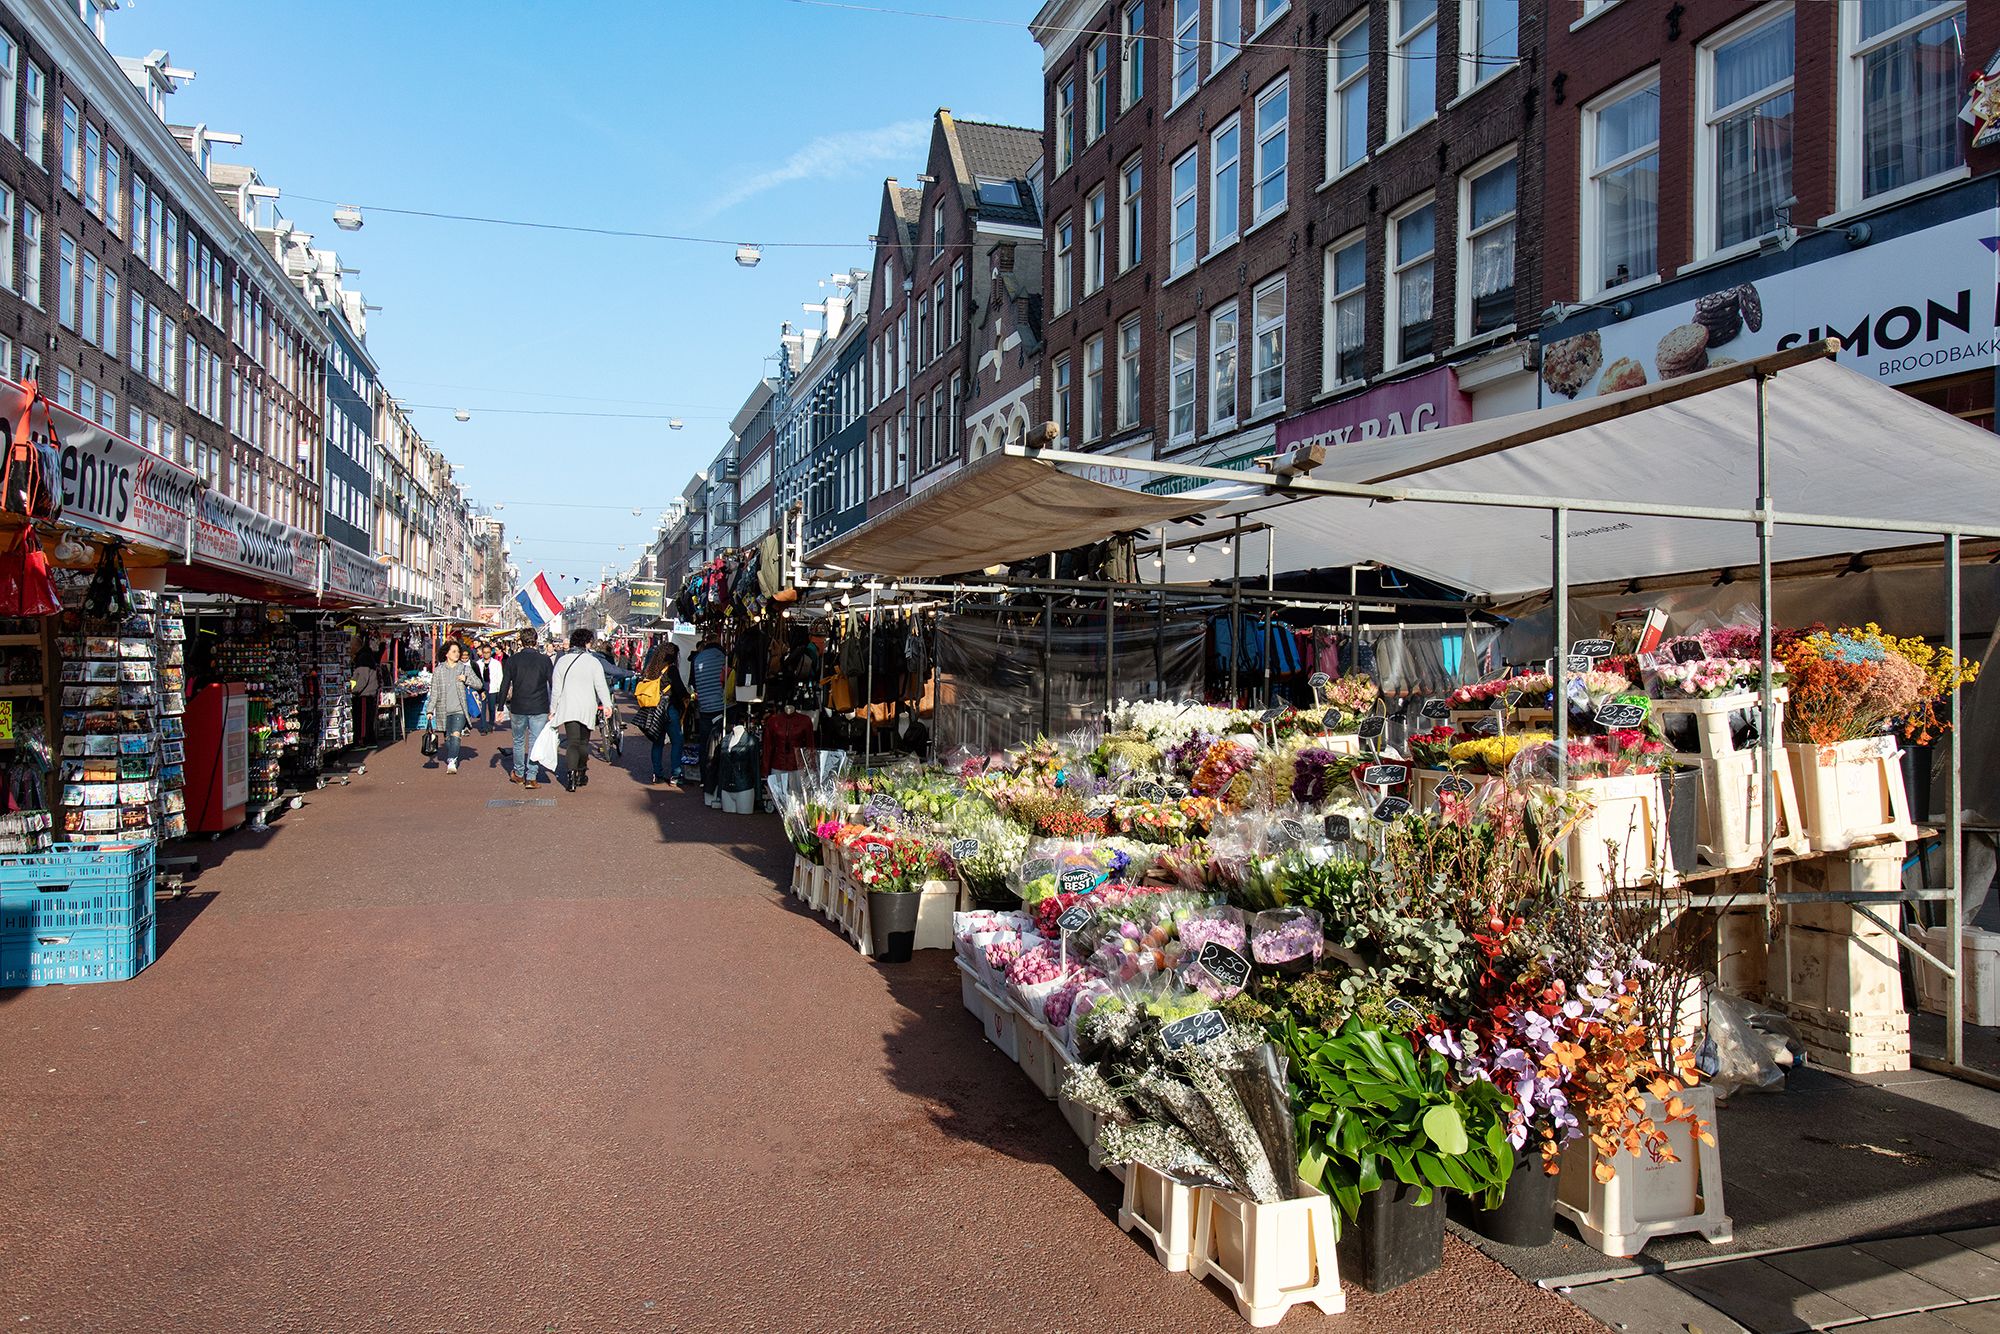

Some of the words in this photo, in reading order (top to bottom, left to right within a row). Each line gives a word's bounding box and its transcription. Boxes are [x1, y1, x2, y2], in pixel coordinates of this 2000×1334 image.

[1286, 425, 1353, 453] CTY
[140, 459, 193, 514] Kruithof
[1079, 464, 1128, 485] AGERIJ
[238, 521, 294, 576] souvenirs
[632, 589, 661, 597] MARGO
[1065, 878, 1091, 891] BEST
